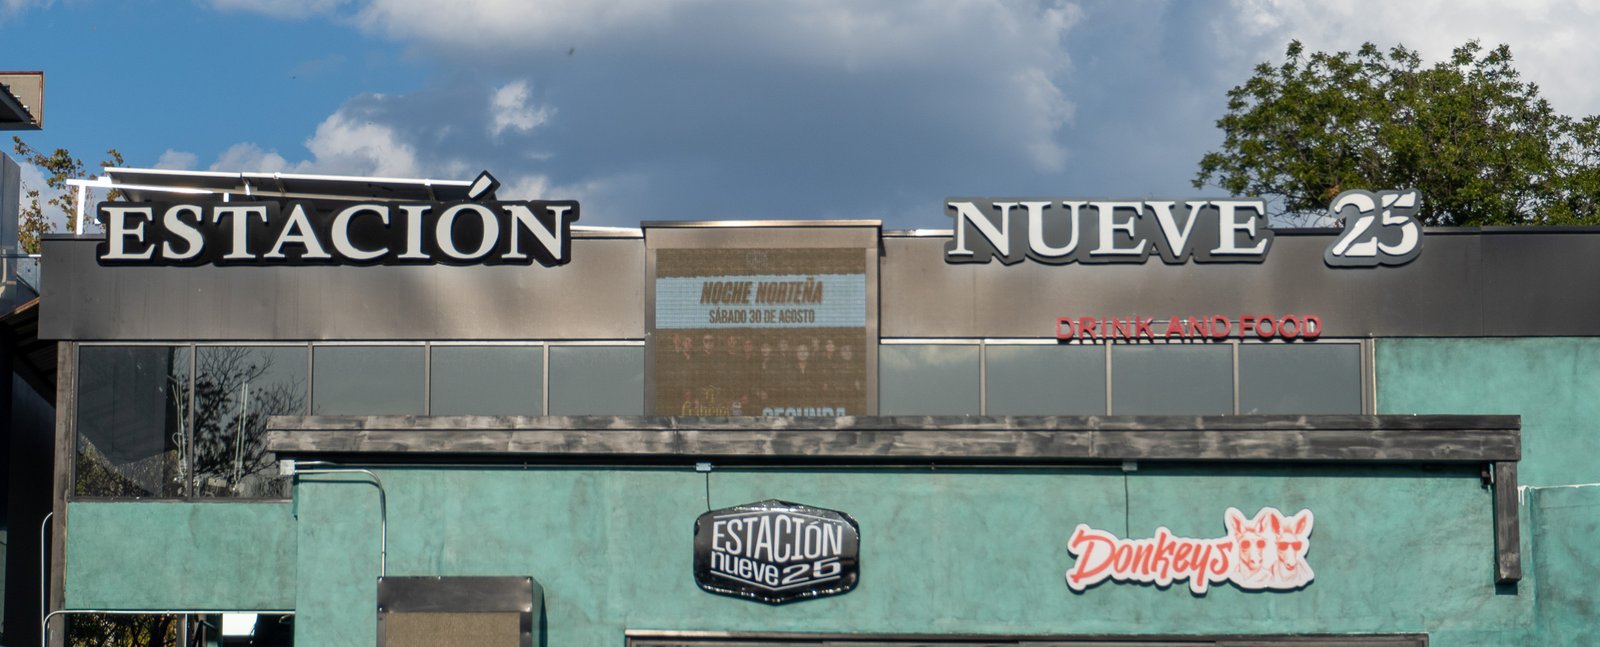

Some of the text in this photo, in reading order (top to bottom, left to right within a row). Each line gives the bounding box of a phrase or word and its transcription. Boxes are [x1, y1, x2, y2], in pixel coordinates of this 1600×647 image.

[101, 174, 573, 262] ESTACIÓN
[947, 190, 1418, 258] NUEVE 25
[700, 276, 823, 304] NOCHE NORTEÑA
[709, 307, 815, 324] SÁBADO 30 DE AGOSTO
[1056, 314, 1322, 340] DRINK AND FOOD
[710, 550, 841, 586] nueve 25
[1070, 529, 1233, 587] Donkeys
